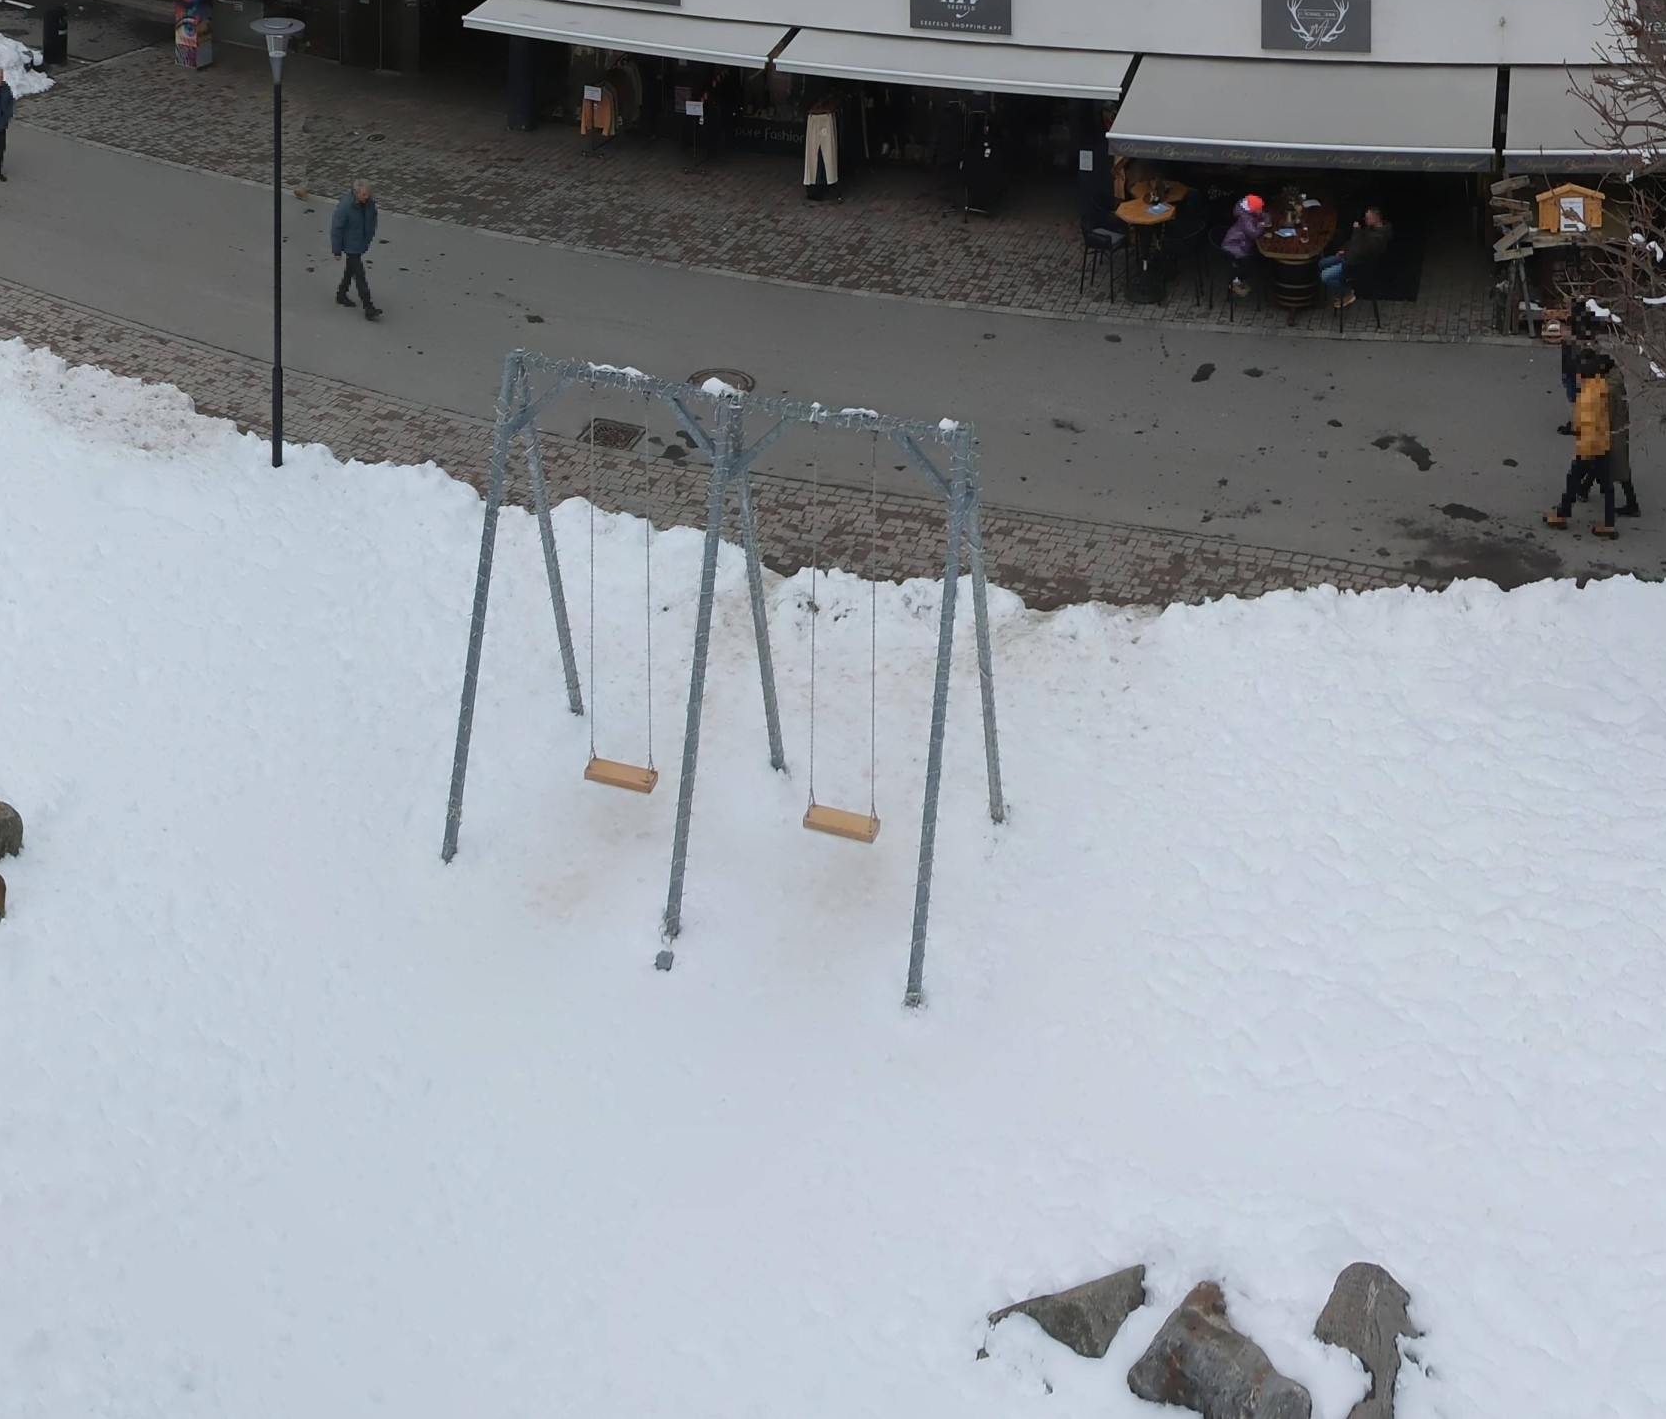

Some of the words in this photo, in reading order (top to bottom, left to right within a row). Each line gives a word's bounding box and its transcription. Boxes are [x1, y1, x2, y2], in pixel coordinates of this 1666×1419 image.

[947, 4, 976, 12] SEEFELD
[951, 22, 986, 30] SHOPPING
[735, 126, 761, 138] pure
